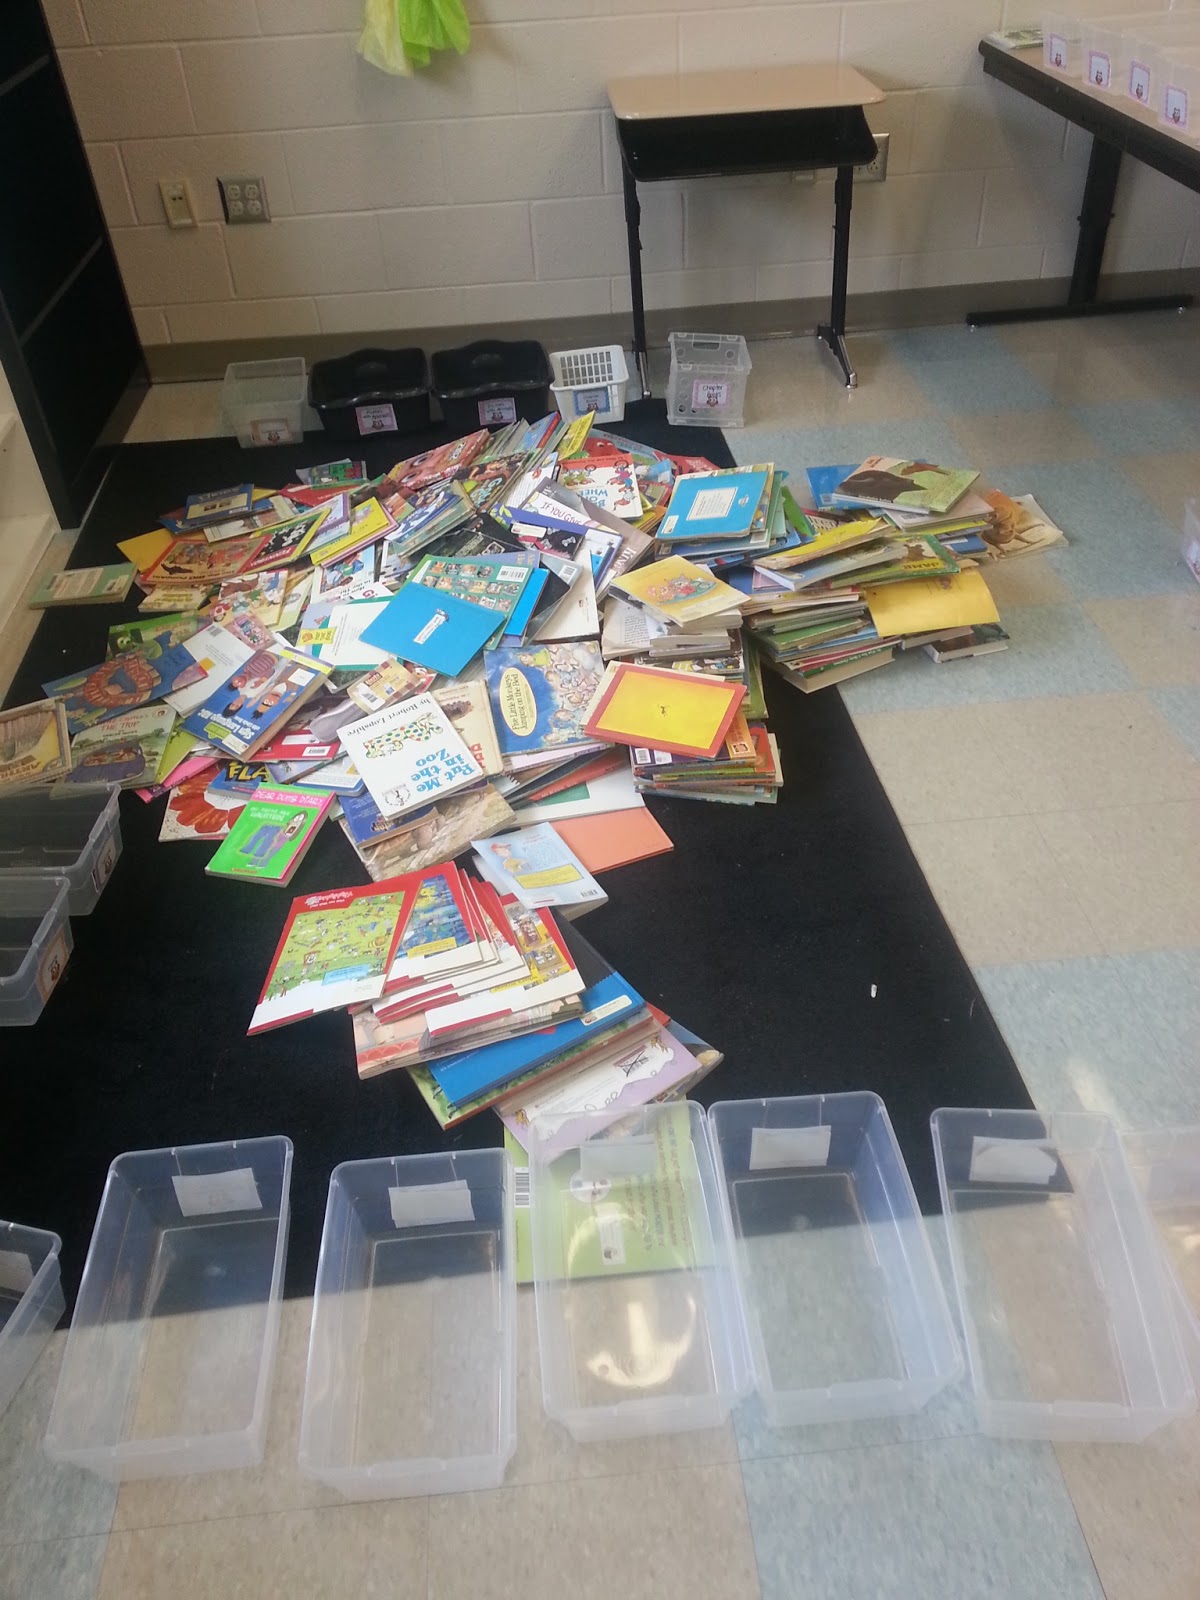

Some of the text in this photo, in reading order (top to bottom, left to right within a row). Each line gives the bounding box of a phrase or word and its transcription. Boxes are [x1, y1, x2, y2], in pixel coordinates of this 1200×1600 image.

[550, 506, 564, 518] YOU
[504, 674, 520, 730] Five Little Monkeys
[511, 673, 528, 729] Jumping on the Bed
[346, 697, 430, 737] by Robert Lopshire
[237, 727, 256, 740] Sign
[415, 748, 450, 767] Zoo
[444, 753, 465, 767] in
[410, 764, 441, 782] the
[416, 762, 475, 793] Put Me
[254, 791, 323, 806] DEAR DUMB DIARY
